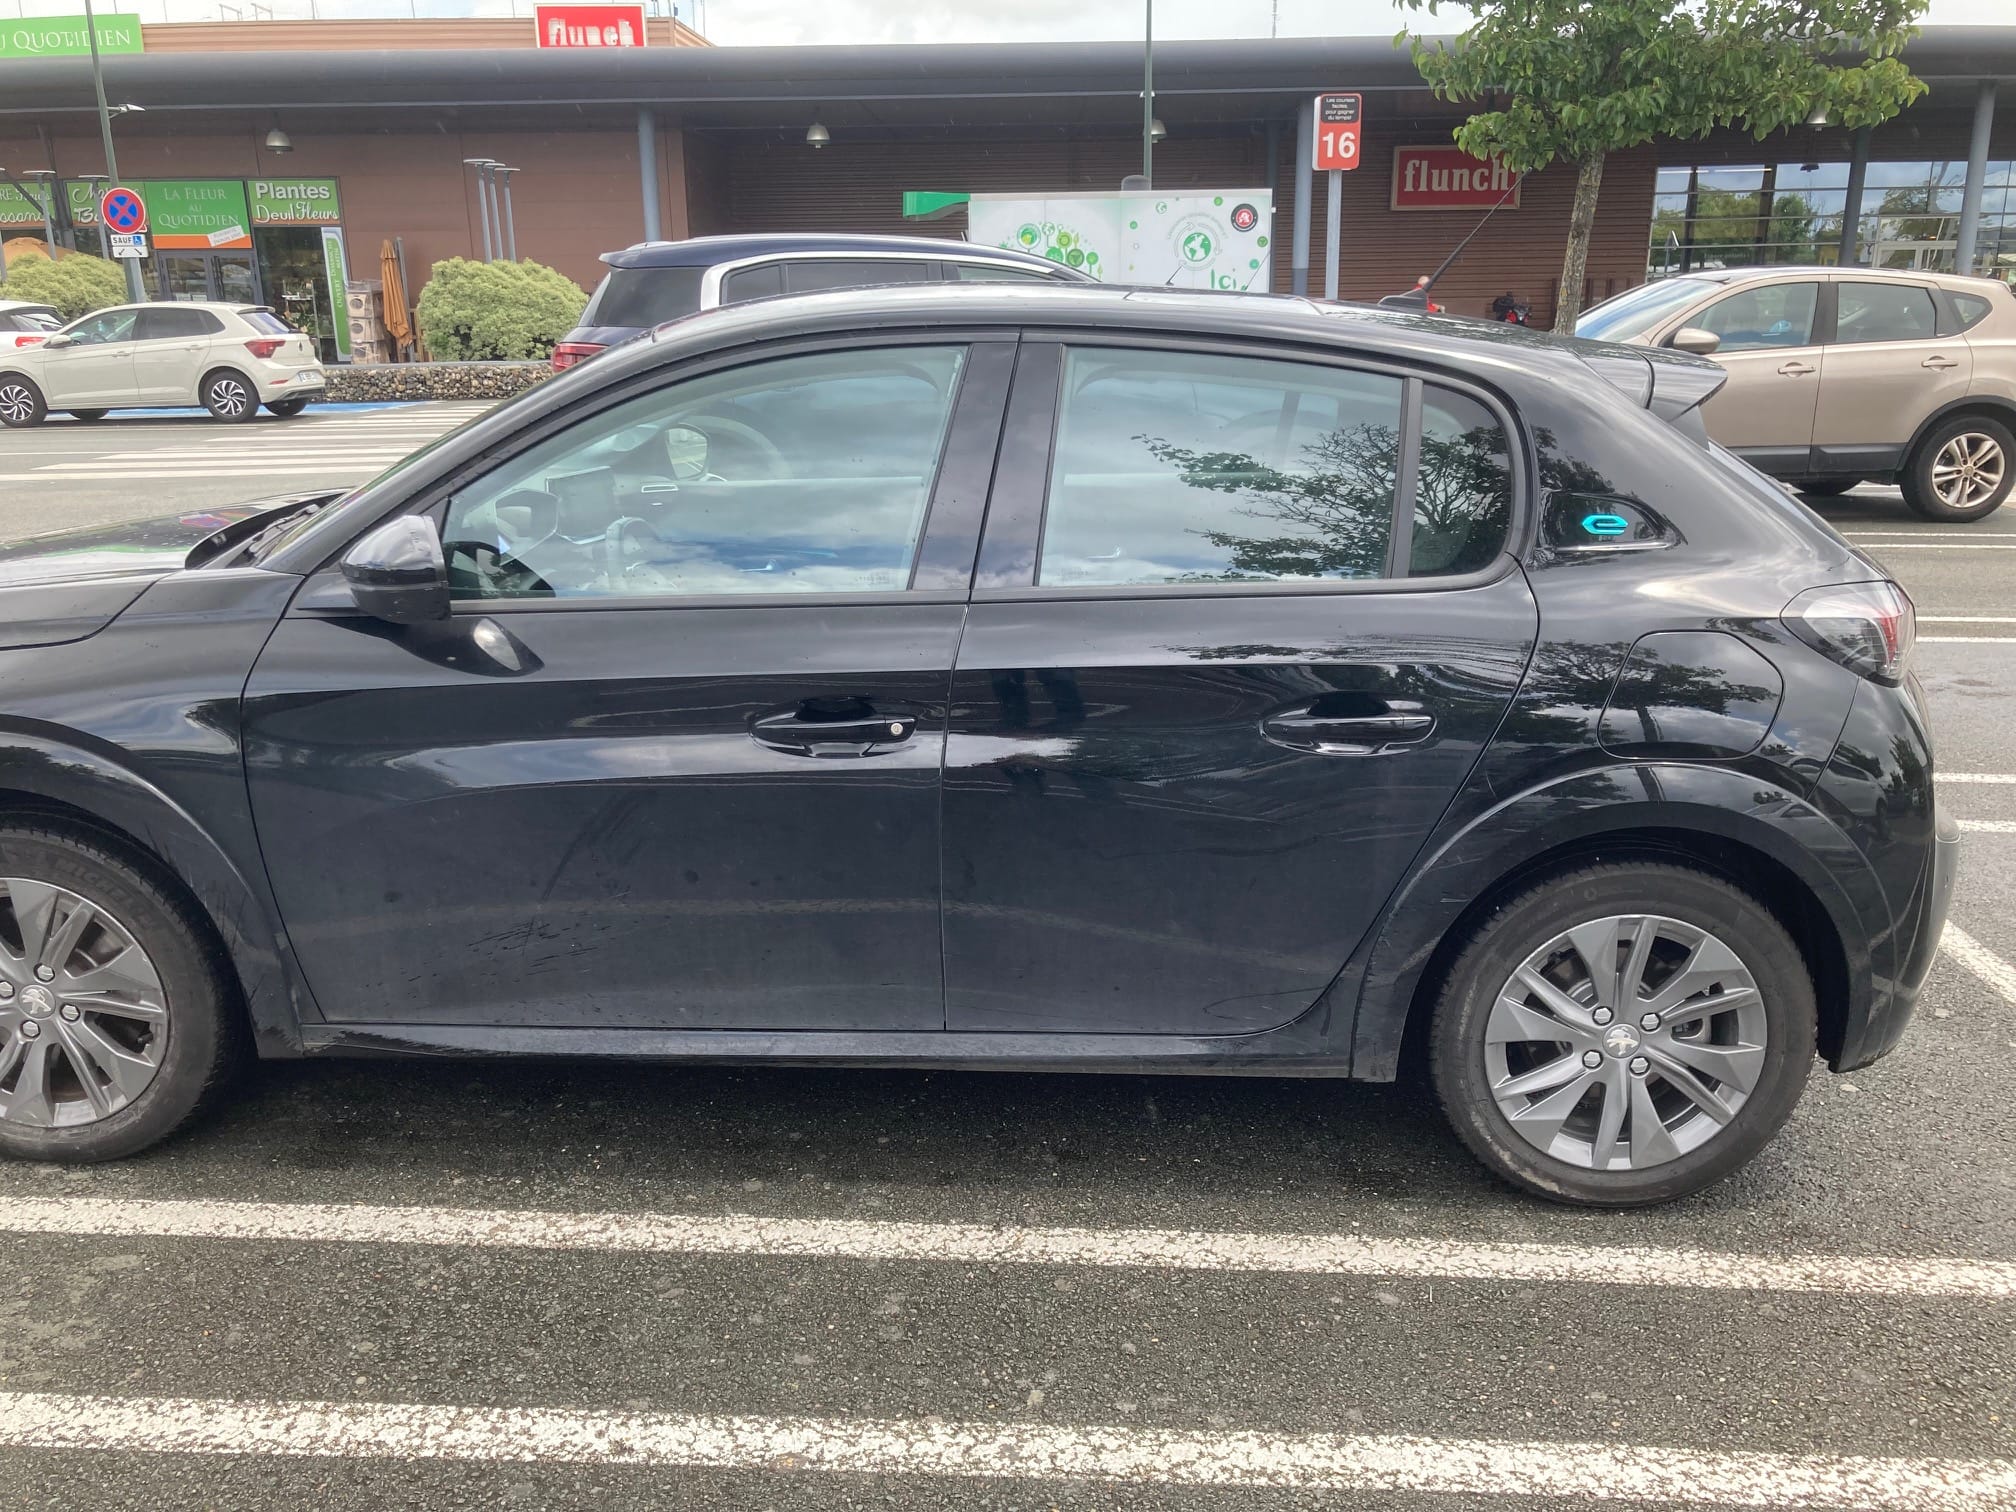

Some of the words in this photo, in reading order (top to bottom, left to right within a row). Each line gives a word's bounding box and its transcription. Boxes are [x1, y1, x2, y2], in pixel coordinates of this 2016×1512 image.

[13, 30, 131, 52] QUOTIDIEN
[548, 17, 635, 46] flunch
[1322, 131, 1356, 159] 16
[1404, 159, 1510, 192] flunch
[255, 182, 330, 199] Plantes
[158, 213, 239, 229] QUOTIDIEN
[255, 203, 294, 223] Deuil
[295, 201, 339, 220] Fleurs
[113, 236, 132, 244] SAUF
